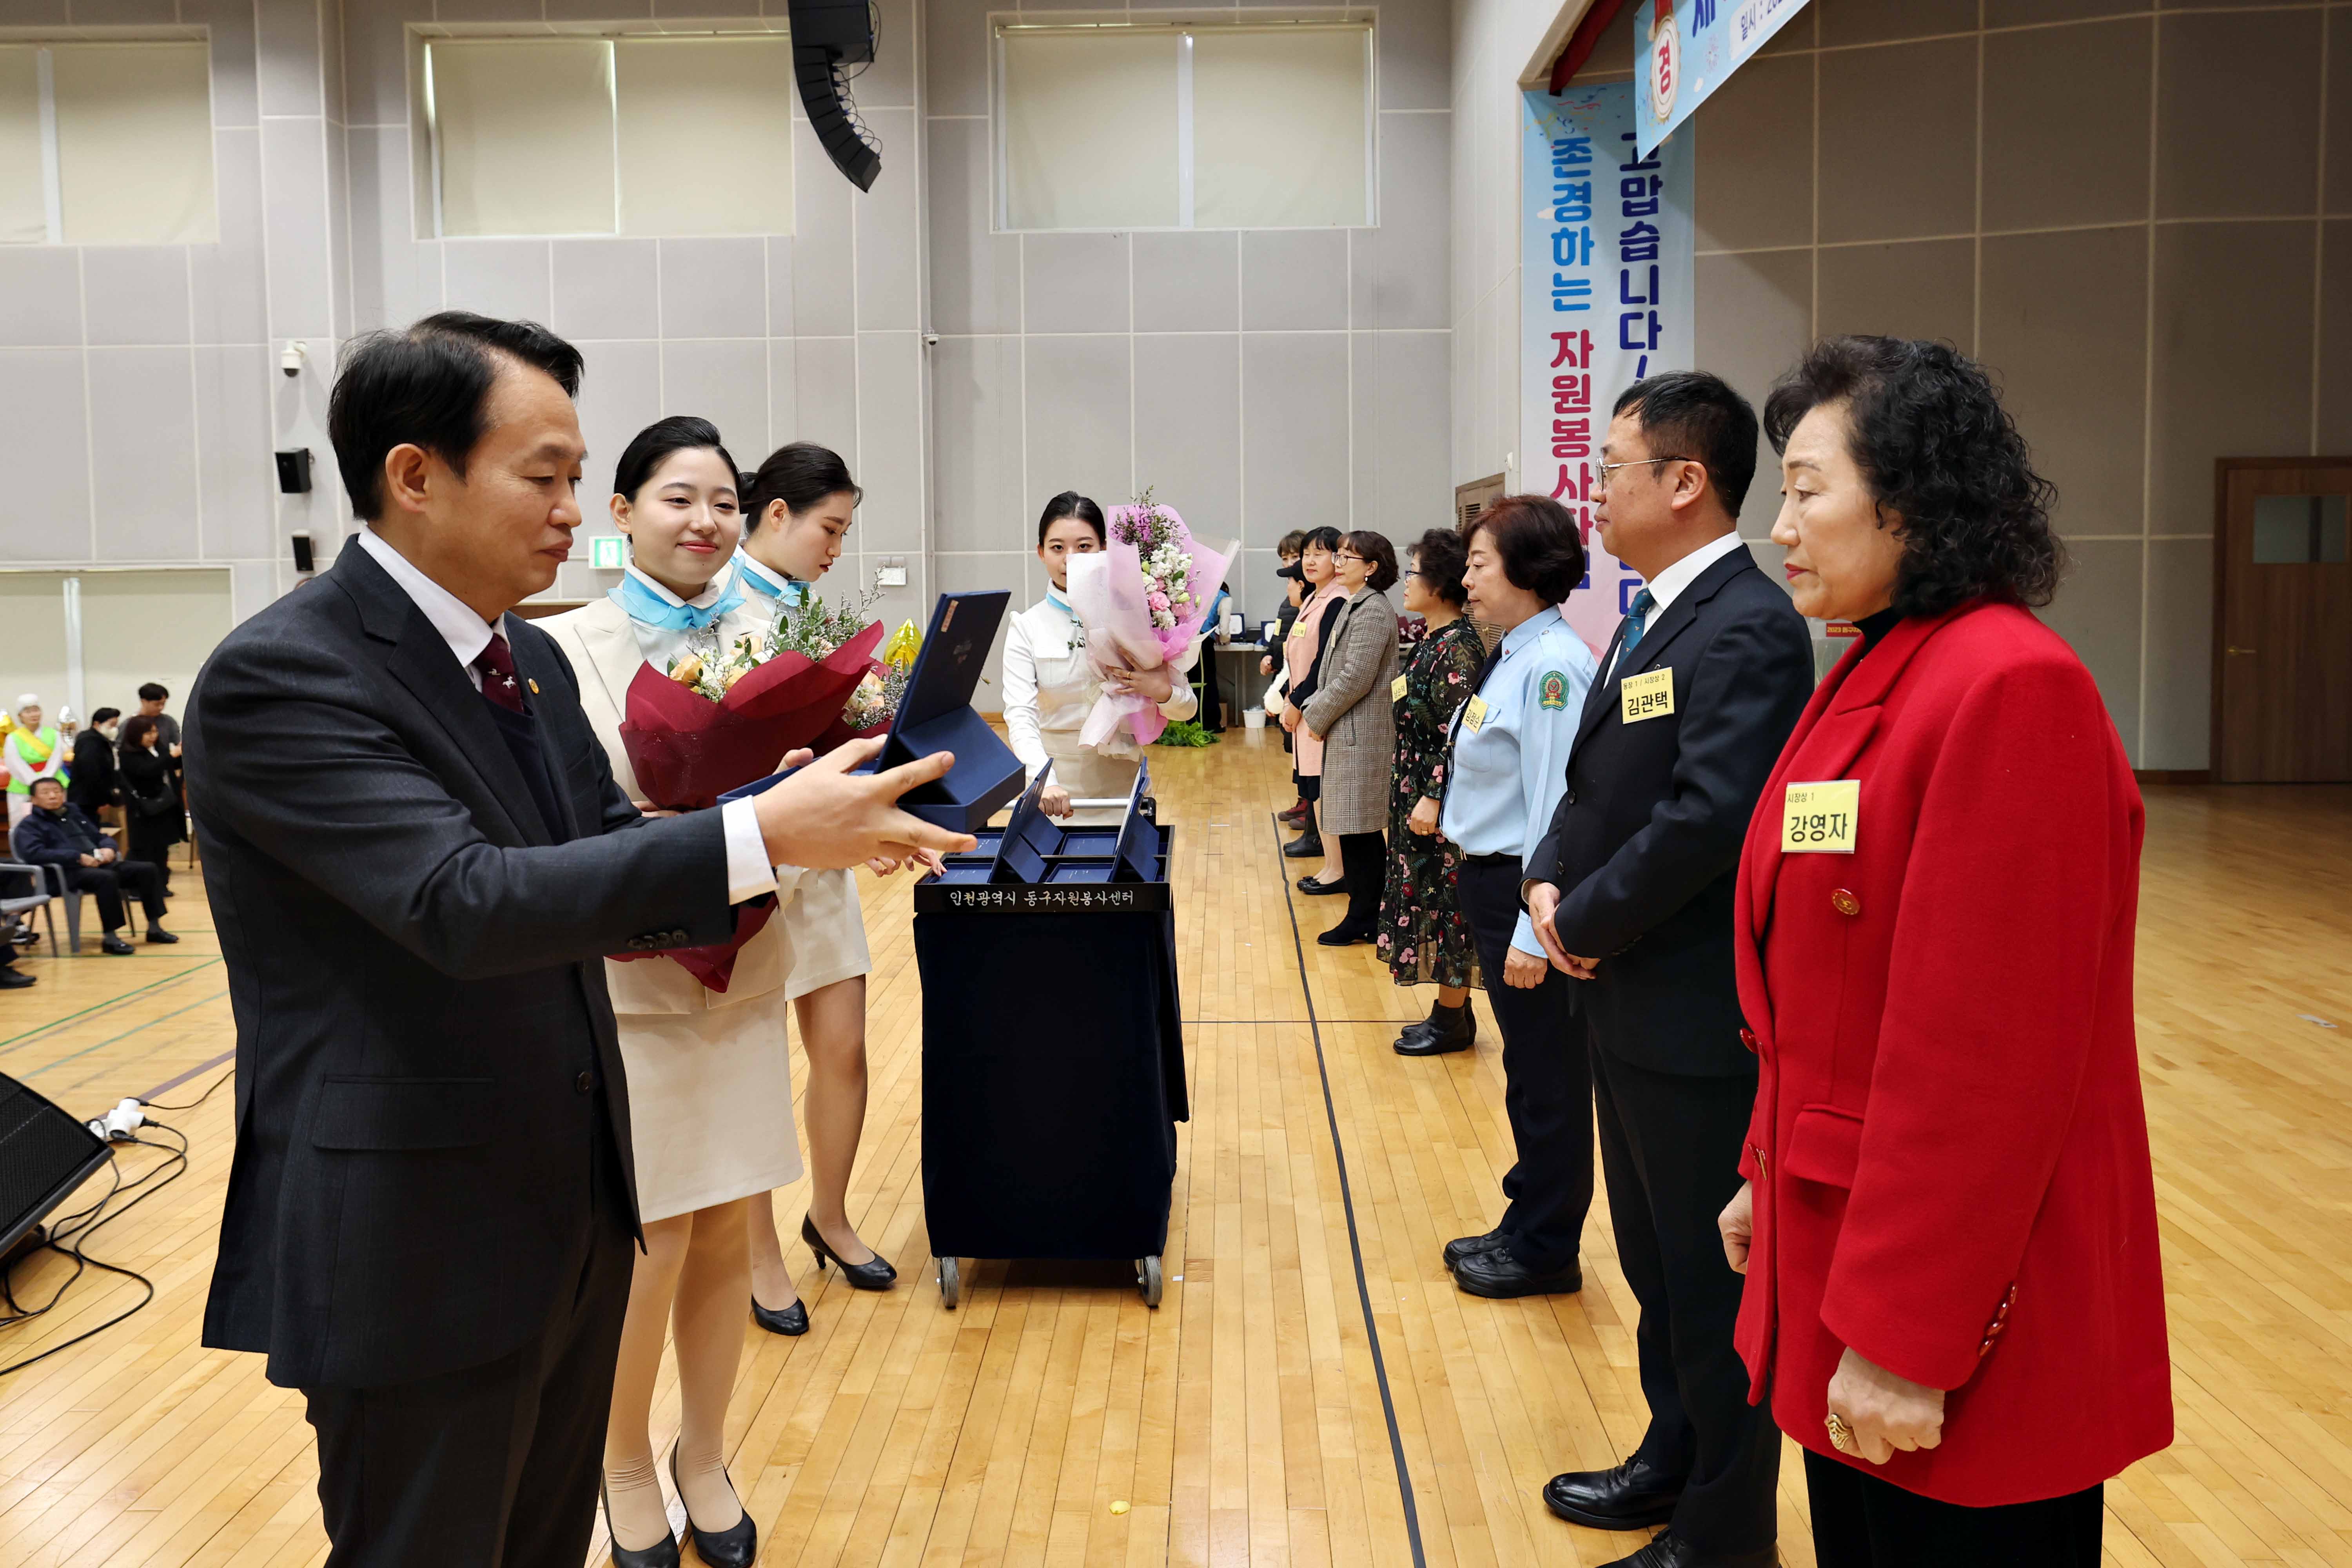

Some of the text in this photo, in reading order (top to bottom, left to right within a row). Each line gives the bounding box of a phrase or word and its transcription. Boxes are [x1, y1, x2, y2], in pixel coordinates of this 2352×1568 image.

[1740, 3, 1756, 41] 일시
[1659, 38, 1671, 94] 경
[1550, 137, 1595, 589] 존경하는 자원봉사
[1628, 691, 1668, 716] 김관택
[1787, 792, 1814, 803] 시장상 1
[1790, 813, 1847, 842] 강영자
[950, 890, 1133, 906] 인천광역시 동구자원봉사센터
